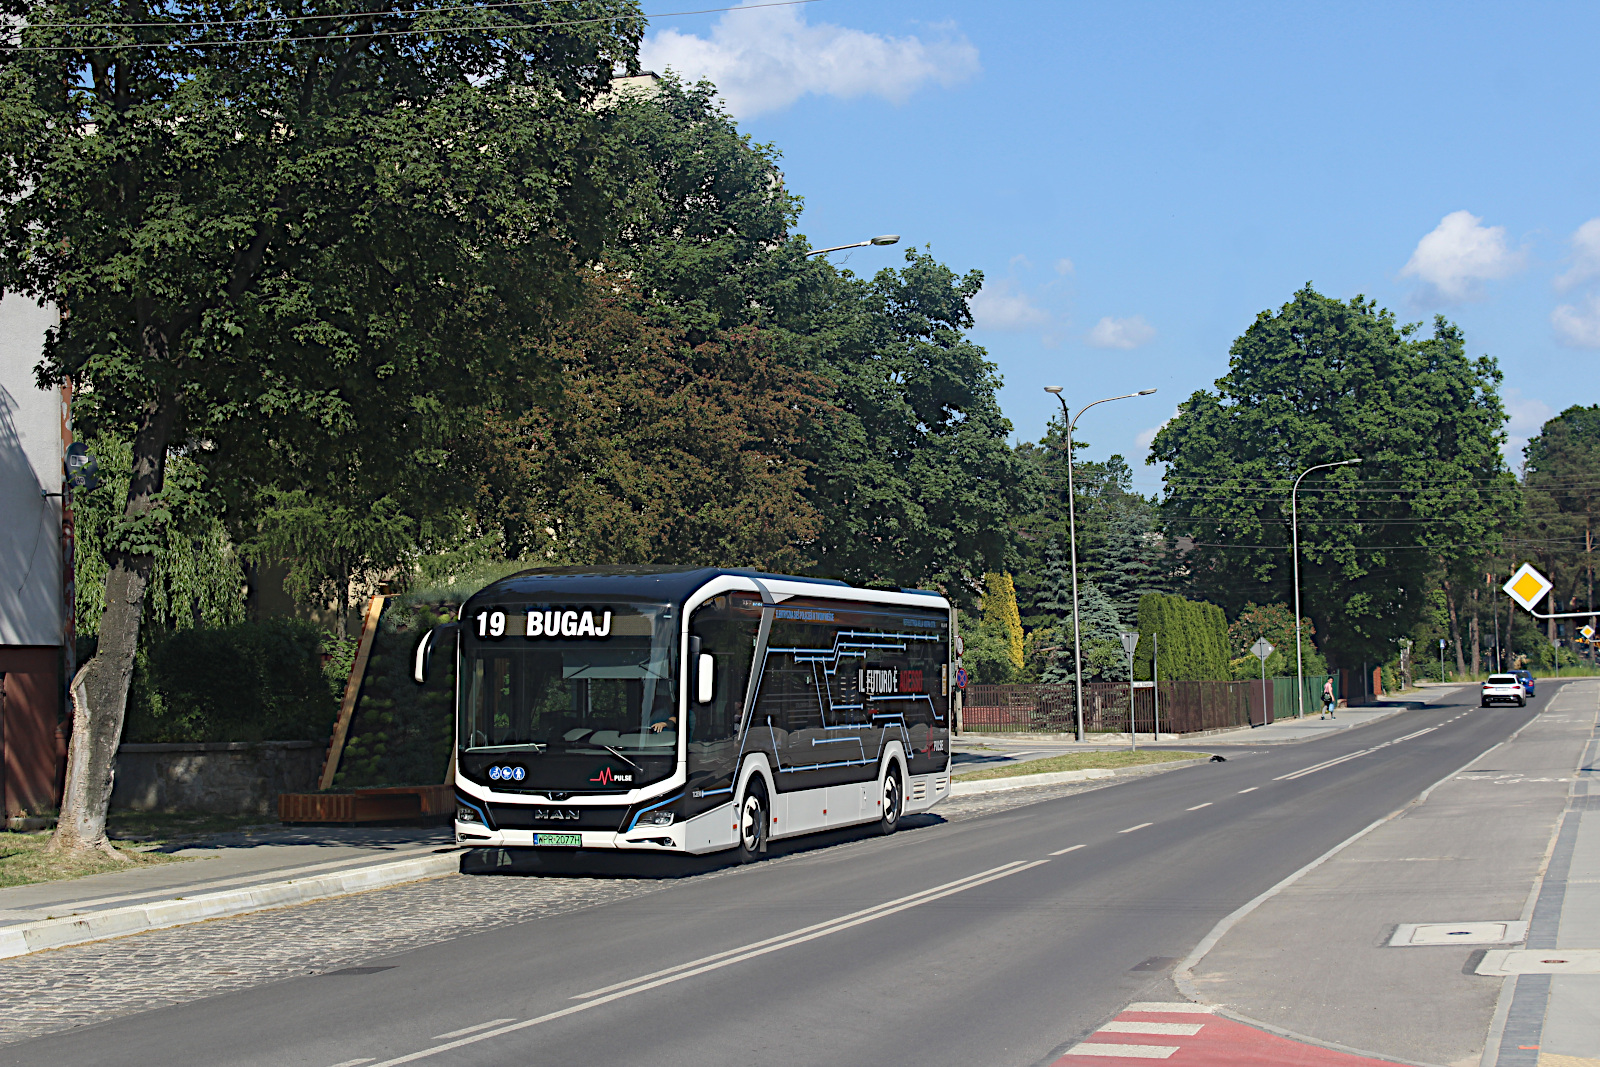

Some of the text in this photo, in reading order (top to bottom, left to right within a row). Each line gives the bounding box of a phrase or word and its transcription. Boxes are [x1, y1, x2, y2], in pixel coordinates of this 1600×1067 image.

[477, 611, 611, 636] 19 BUGAJ
[858, 669, 865, 692] IL
[866, 669, 892, 693] FUTURO
[899, 669, 923, 692] ADESSO
[933, 740, 944, 751] PULSE
[613, 774, 632, 782] PULSE
[535, 809, 580, 820] MAN
